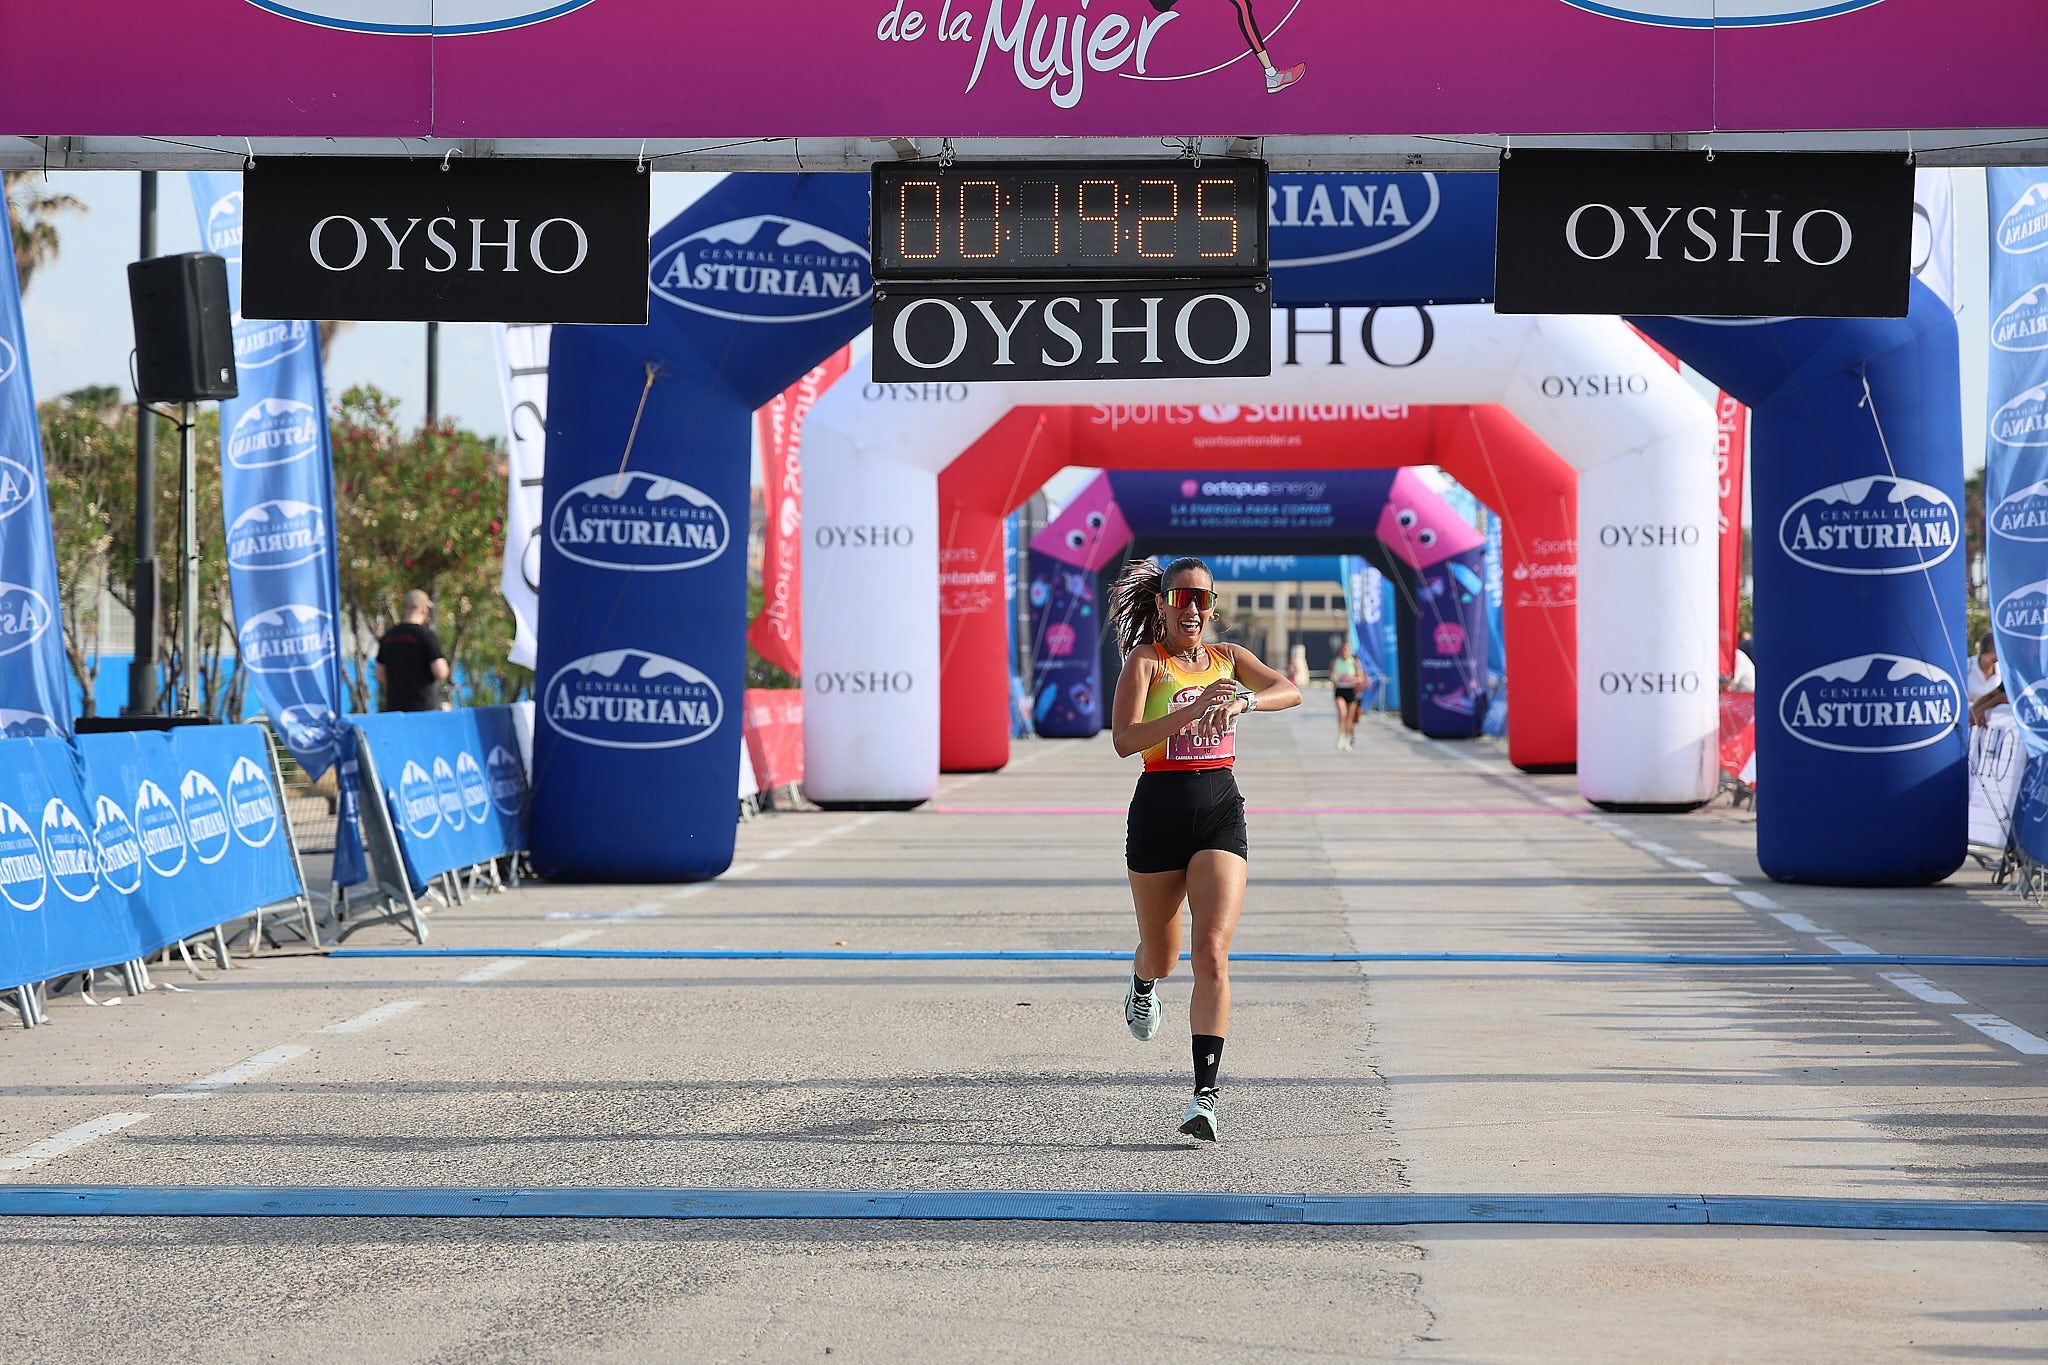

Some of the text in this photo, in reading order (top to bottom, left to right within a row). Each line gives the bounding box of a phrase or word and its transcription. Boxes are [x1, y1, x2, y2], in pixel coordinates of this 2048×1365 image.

[877, 0, 1181, 109] de la Mujer
[900, 180, 1238, 259] 00:19:25
[309, 215, 588, 275] OYSHO
[1565, 203, 1853, 266] OYSHO
[700, 249, 860, 268] CENTRAL LECHERA
[892, 293, 1251, 369] OYSHO
[862, 382, 968, 403] OYSHO
[1541, 374, 1648, 399] OYSHO
[1090, 402, 1410, 432] Sports Santander
[582, 503, 715, 520] CENTRAL LECHERA
[1820, 508, 1888, 521] CENTRAL
[814, 524, 914, 549] OYSHO
[1599, 524, 1699, 549] OYSHO
[576, 681, 708, 697] CENTRAL LECHERA
[813, 670, 913, 695] OYSHO
[1598, 670, 1699, 696] OYSHO
[1820, 685, 1949, 698] CENTRAL LECHERA
